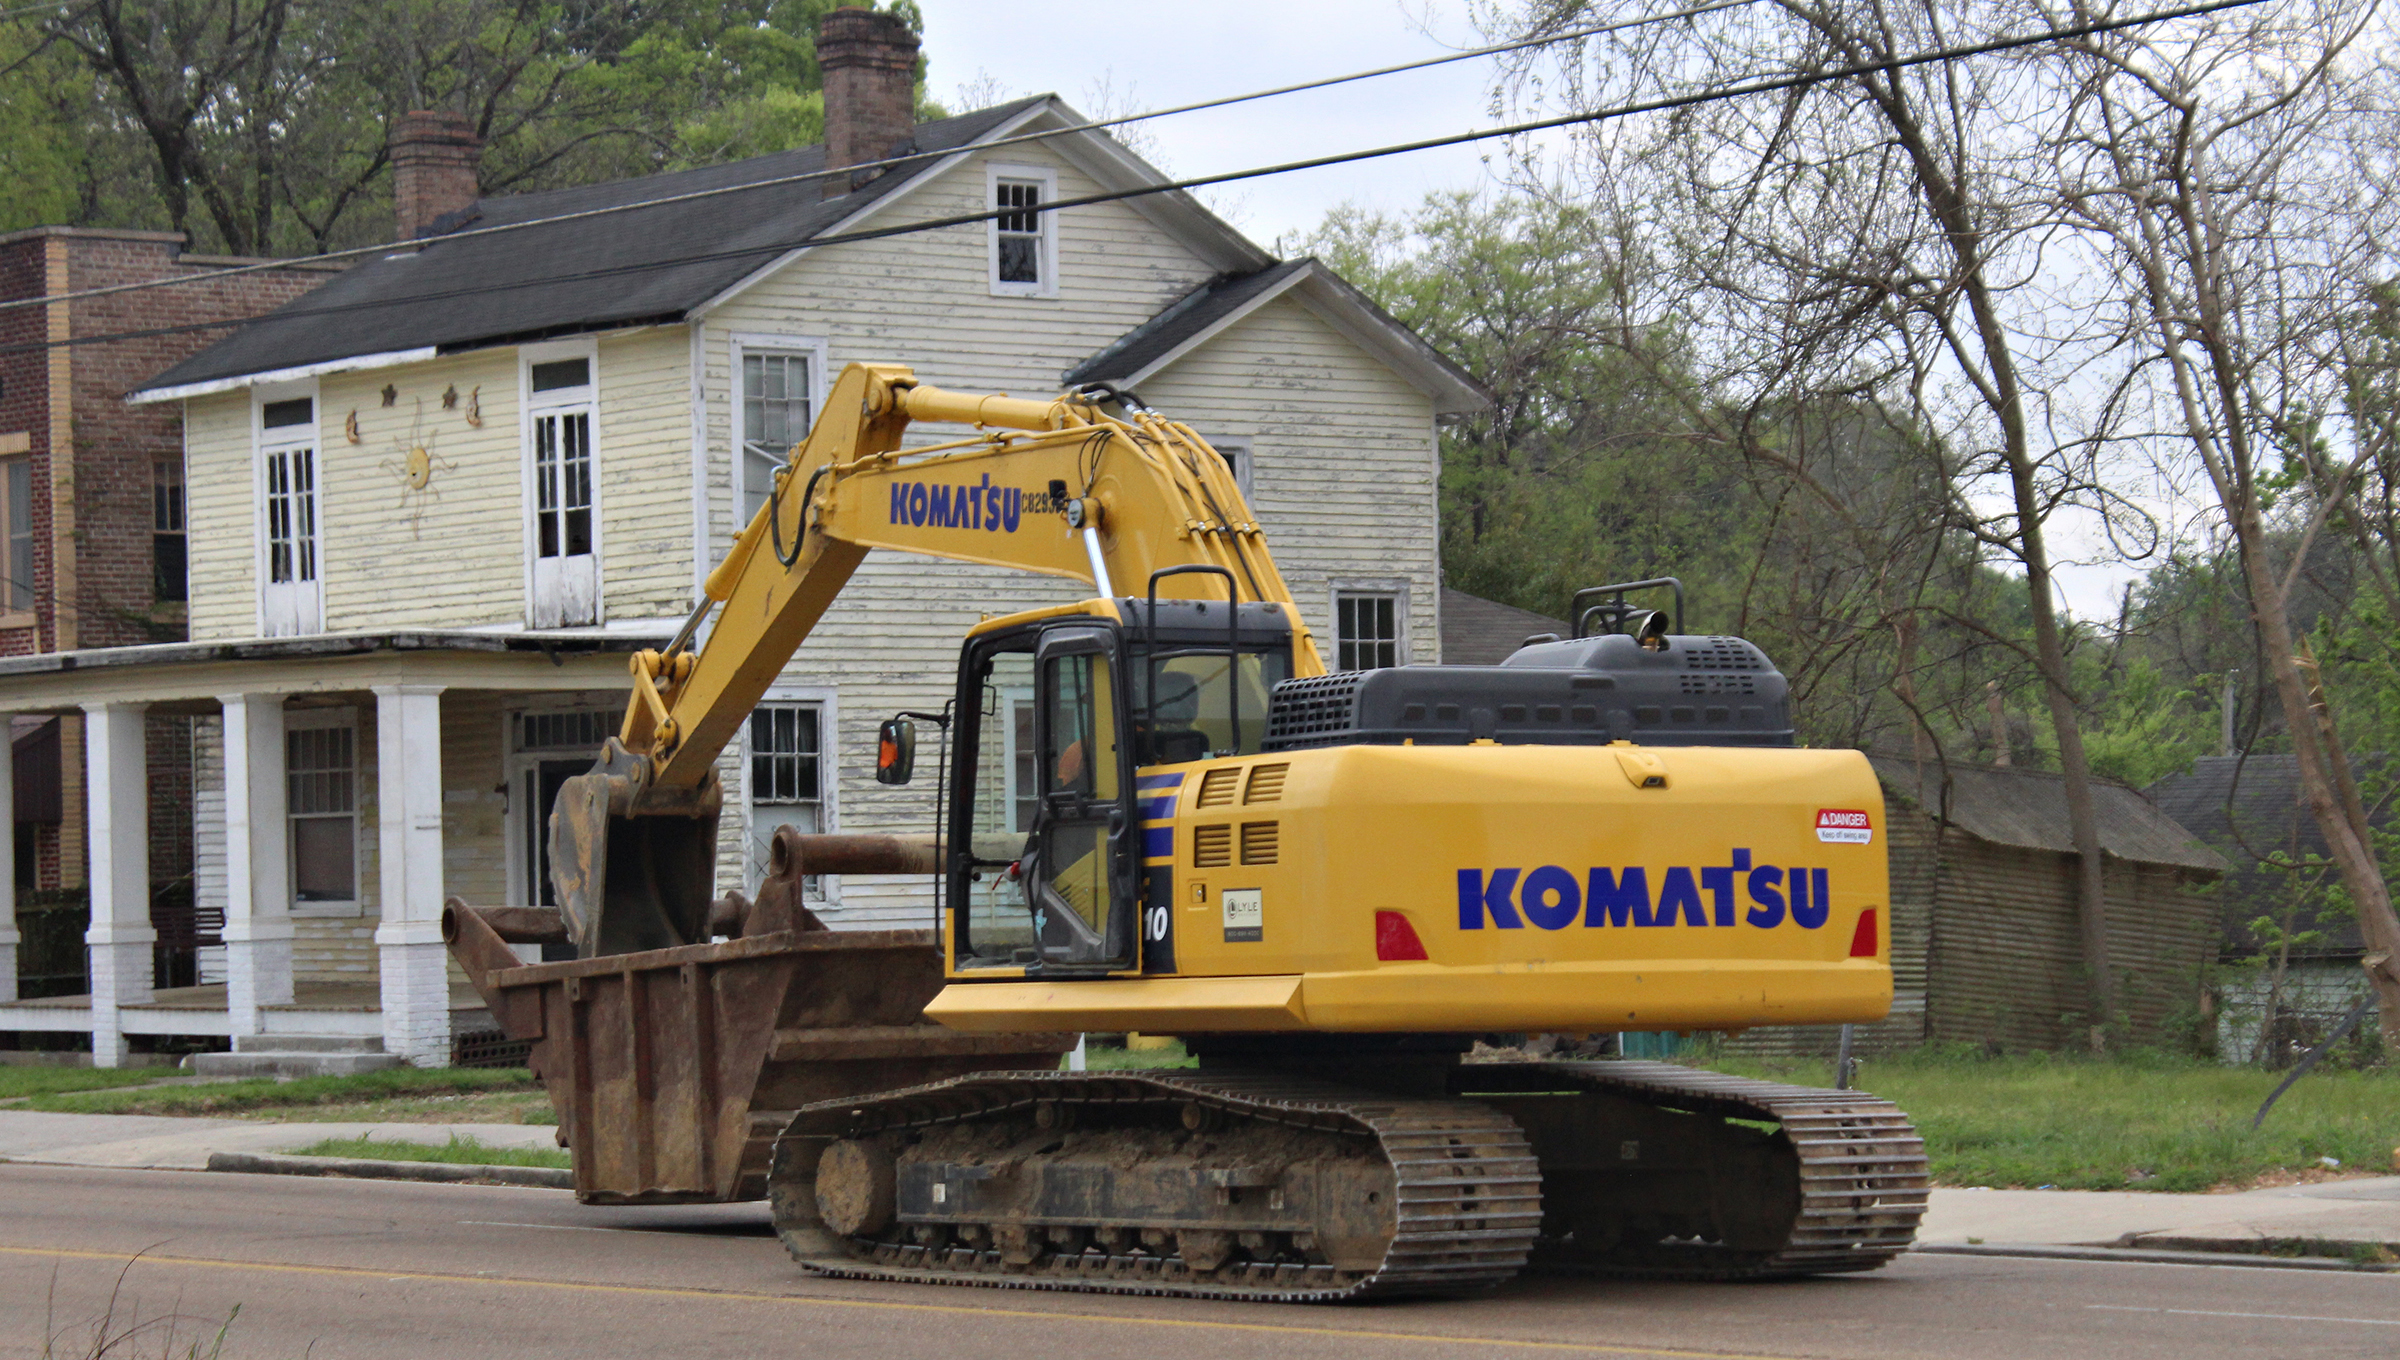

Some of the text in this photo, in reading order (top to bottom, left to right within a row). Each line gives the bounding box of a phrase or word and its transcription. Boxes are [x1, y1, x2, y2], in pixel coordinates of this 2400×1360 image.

[890, 473, 1021, 533] KOMATSU
[1022, 492, 1061, 514] C829
[1830, 813, 1867, 826] DANGER
[1457, 848, 1830, 931] KOMATSU
[1238, 902, 1258, 912] LYLE
